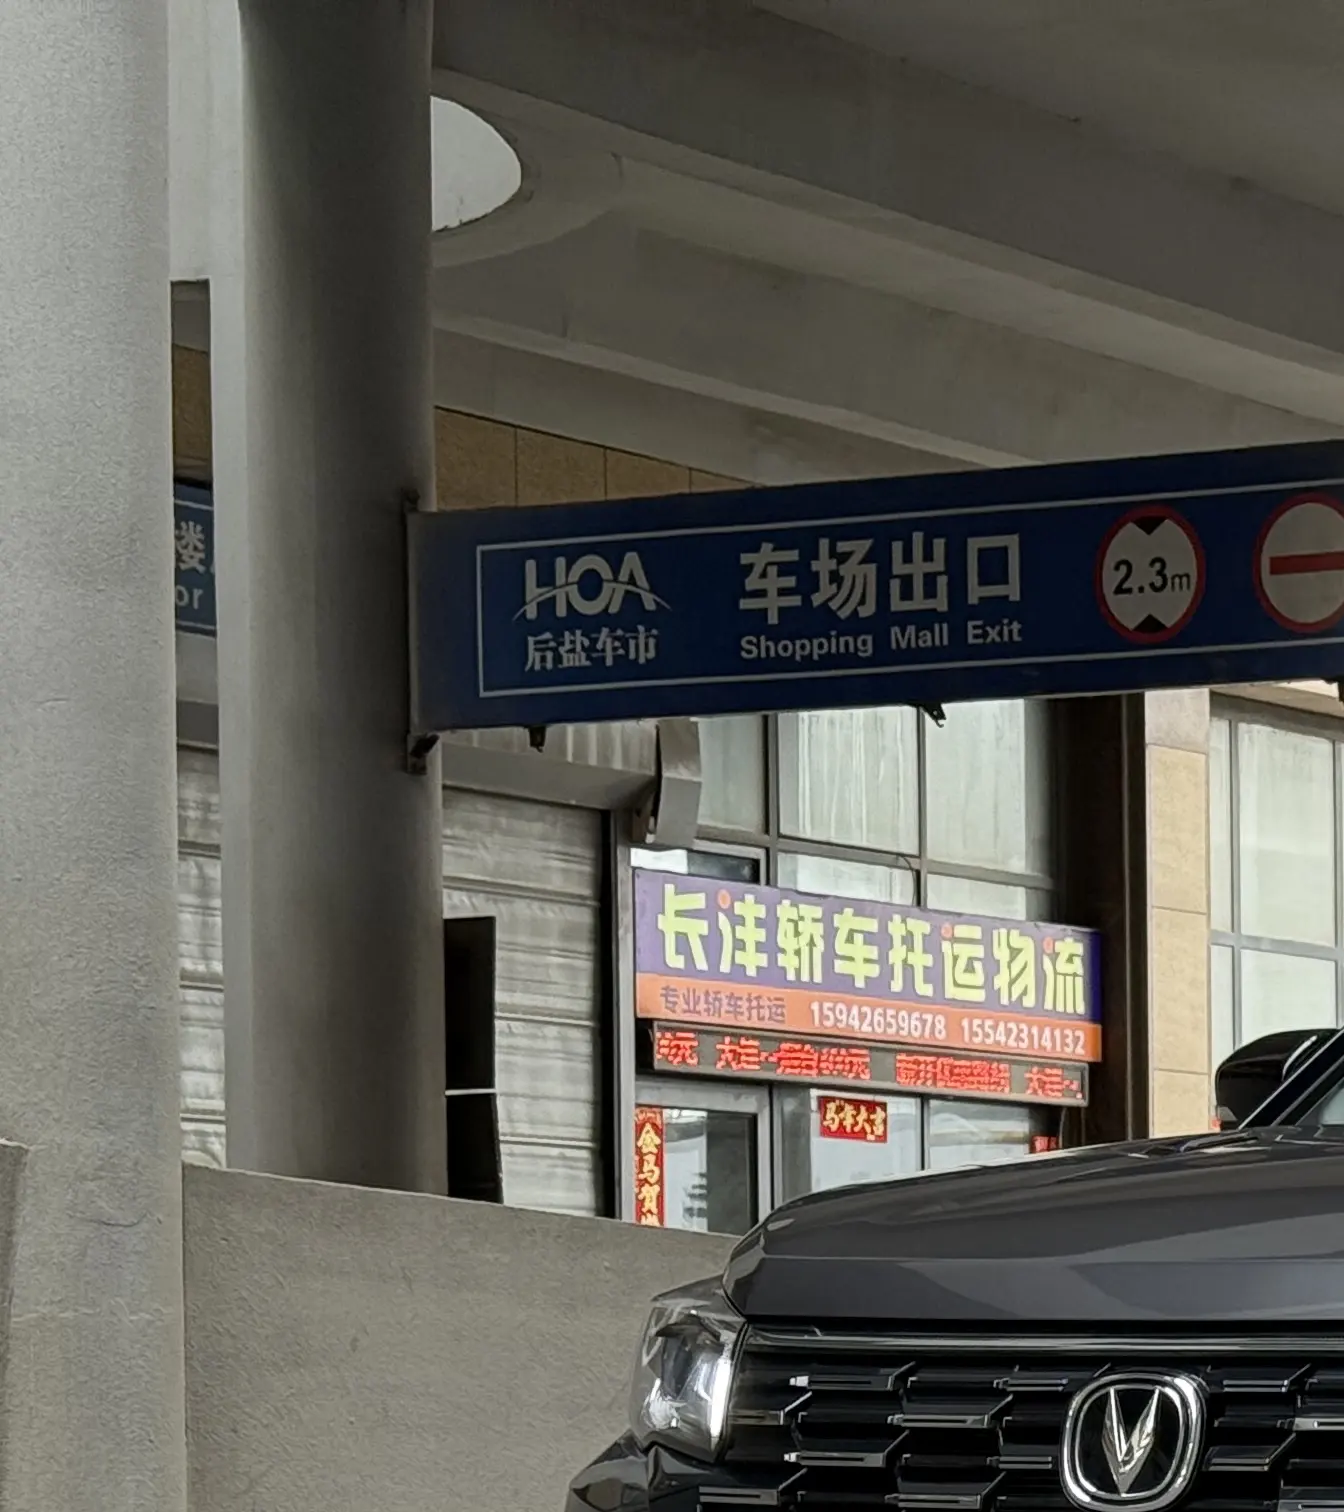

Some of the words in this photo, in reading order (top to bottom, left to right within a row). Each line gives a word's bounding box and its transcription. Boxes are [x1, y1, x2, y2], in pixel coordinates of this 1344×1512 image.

[524, 551, 657, 620] HOA
[739, 531, 1021, 625] 车场出口
[1112, 556, 1191, 595] 2.3m
[525, 625, 661, 671] 后盐车市
[740, 631, 873, 662] Shopping
[891, 623, 949, 649] Mall
[967, 618, 1022, 644] Exit
[660, 984, 786, 1023] 专业轿车托运
[810, 1000, 947, 1040] 15942659678
[960, 1017, 1086, 1056] 15542314132
